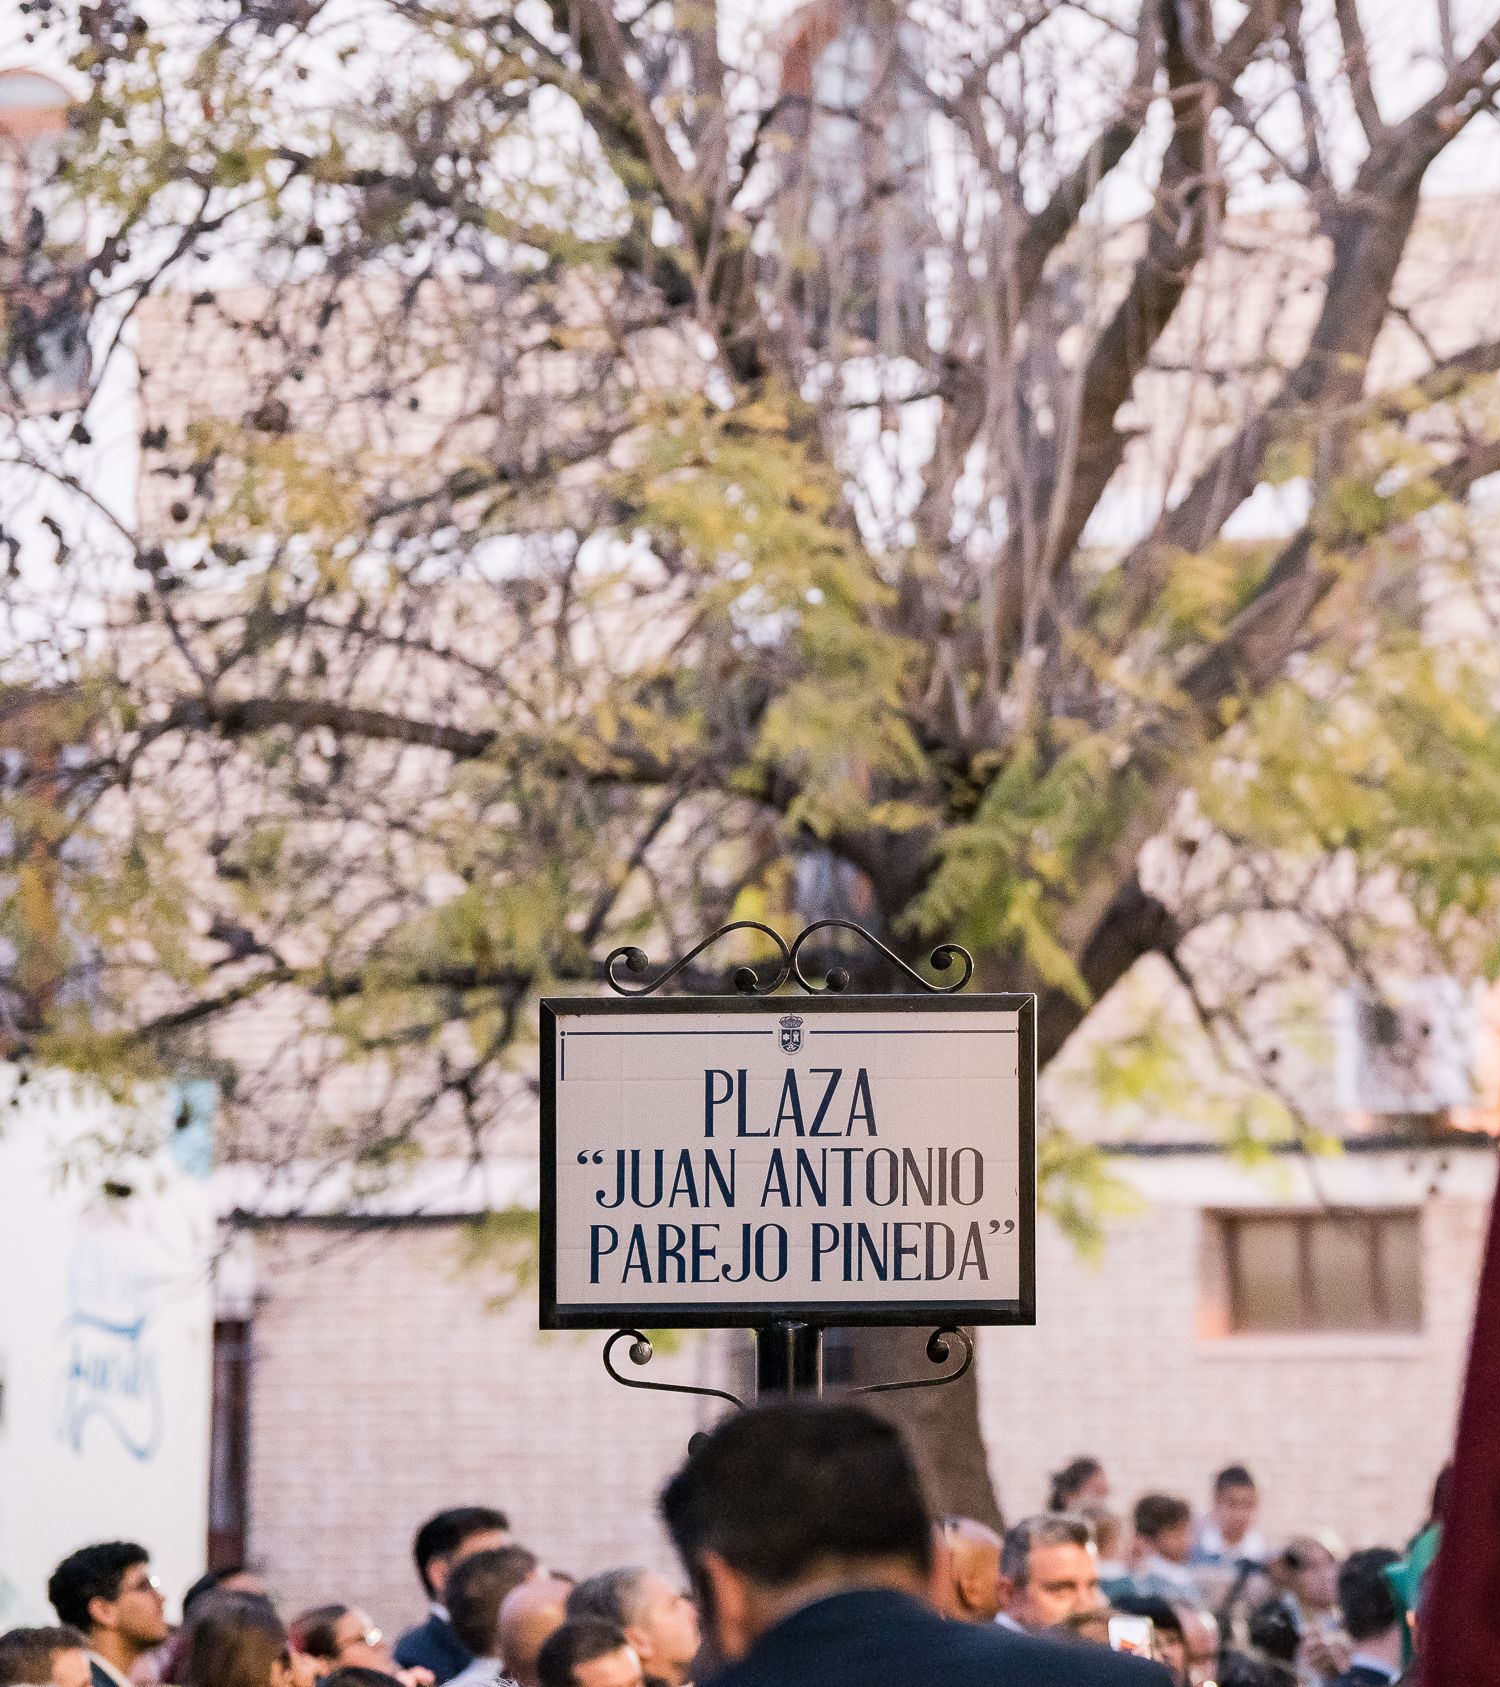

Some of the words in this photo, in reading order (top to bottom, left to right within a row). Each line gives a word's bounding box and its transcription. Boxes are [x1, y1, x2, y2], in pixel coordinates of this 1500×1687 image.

[703, 1067, 878, 1138] PLAZA
[576, 1148, 737, 1209] “JUAN
[759, 1147, 984, 1208] ANTONIO
[589, 1222, 788, 1284] PAREJO
[810, 1219, 1015, 1283] PINEDA”
